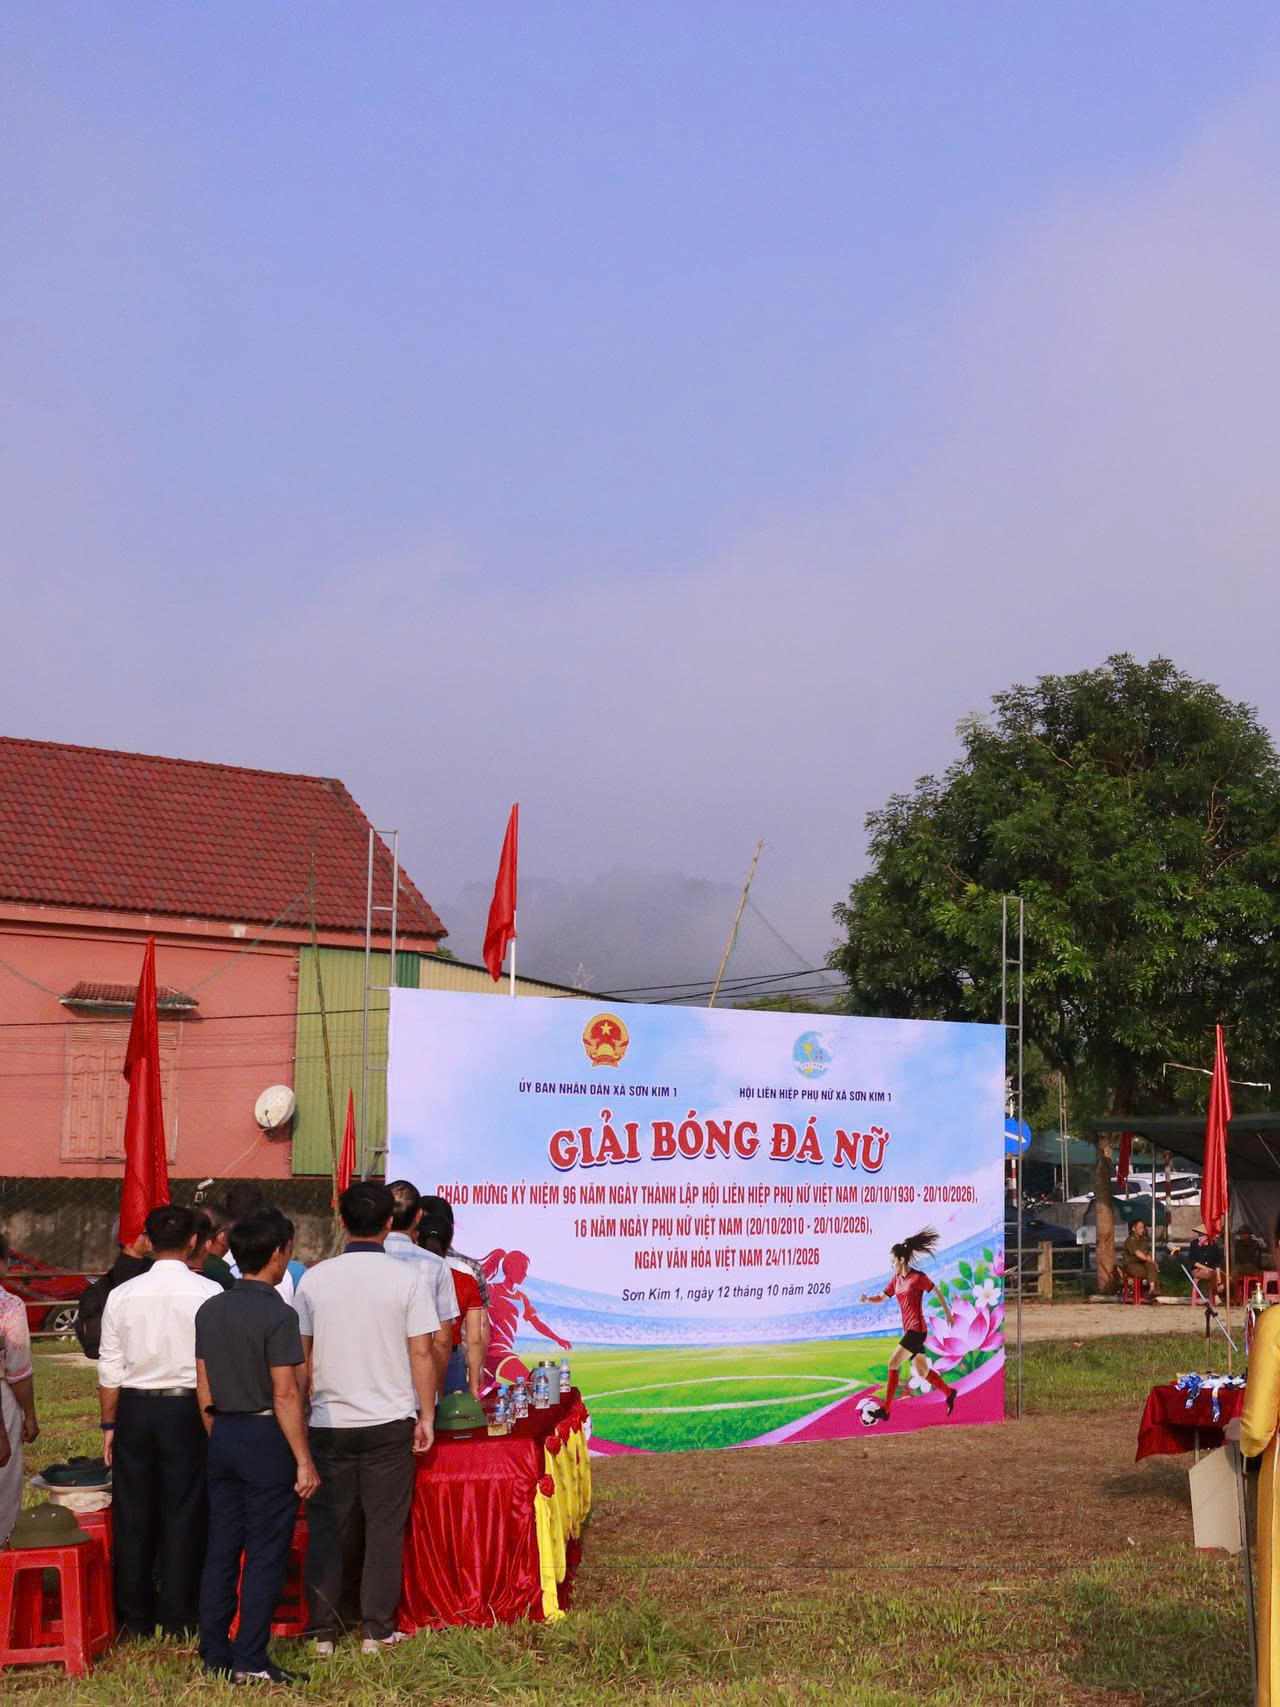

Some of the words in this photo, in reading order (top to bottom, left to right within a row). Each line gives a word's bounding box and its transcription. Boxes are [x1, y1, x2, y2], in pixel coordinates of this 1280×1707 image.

[535, 1082, 556, 1094] BAN
[559, 1081, 587, 1095] NHÂN
[590, 1082, 610, 1096] DÂN
[629, 1084, 649, 1097] SƠN
[651, 1086, 670, 1097] KIM
[673, 1087, 677, 1098] 1
[739, 1085, 755, 1101] HỘI
[757, 1085, 776, 1099] LIÊN
[779, 1086, 799, 1102] HIỆP
[801, 1089, 819, 1103] PHỤ
[850, 1089, 867, 1101] SƠN
[869, 1091, 885, 1102] KIM
[887, 1092, 892, 1102] 1
[549, 1110, 641, 1169] GIẢI
[651, 1110, 760, 1159] BÓNG
[770, 1116, 823, 1162] ĐÁ
[834, 1126, 890, 1170] NỮ
[437, 1181, 469, 1204] CHÀO
[473, 1181, 508, 1204] MỪNG
[511, 1179, 527, 1204] KỶ
[530, 1181, 559, 1208] NIỆM
[563, 1186, 576, 1204] 96
[580, 1182, 605, 1204] NĂM
[609, 1181, 638, 1204] NGÀY
[642, 1181, 676, 1204] THÀNH
[680, 1182, 698, 1208] LẬP
[703, 1182, 719, 1208] HỘI
[723, 1182, 745, 1203] LIÊN
[748, 1182, 770, 1208] HIỆP
[774, 1186, 793, 1207] PHỤ
[797, 1182, 812, 1203] NỮ
[813, 1182, 833, 1207] VIỆT
[836, 1186, 858, 1203] NAM
[861, 1185, 915, 1204] (20/10/1930
[574, 1219, 587, 1237] 16
[591, 1215, 616, 1237] NĂM
[620, 1215, 649, 1237] NGÀY
[652, 1218, 672, 1240] PHỤ
[676, 1214, 693, 1236] NỮ
[694, 1214, 715, 1239] VIỆT
[719, 1218, 742, 1235] NAM
[746, 1217, 804, 1236] (20/10/2010
[634, 1247, 663, 1270] NGÀY
[667, 1247, 687, 1269] VĂN
[691, 1247, 711, 1268] HÓA
[715, 1246, 737, 1271] VIỆT
[740, 1249, 763, 1267] NAM
[765, 1248, 820, 1267] 24/11/2026
[622, 1288, 645, 1301] Sơn
[649, 1288, 671, 1300] Kim
[675, 1287, 683, 1301] 1,
[687, 1286, 714, 1301] ngày
[718, 1285, 730, 1298] 12
[733, 1284, 763, 1300] tháng
[766, 1284, 778, 1297] 10
[782, 1283, 804, 1296] năm
[807, 1282, 831, 1294] 2026
